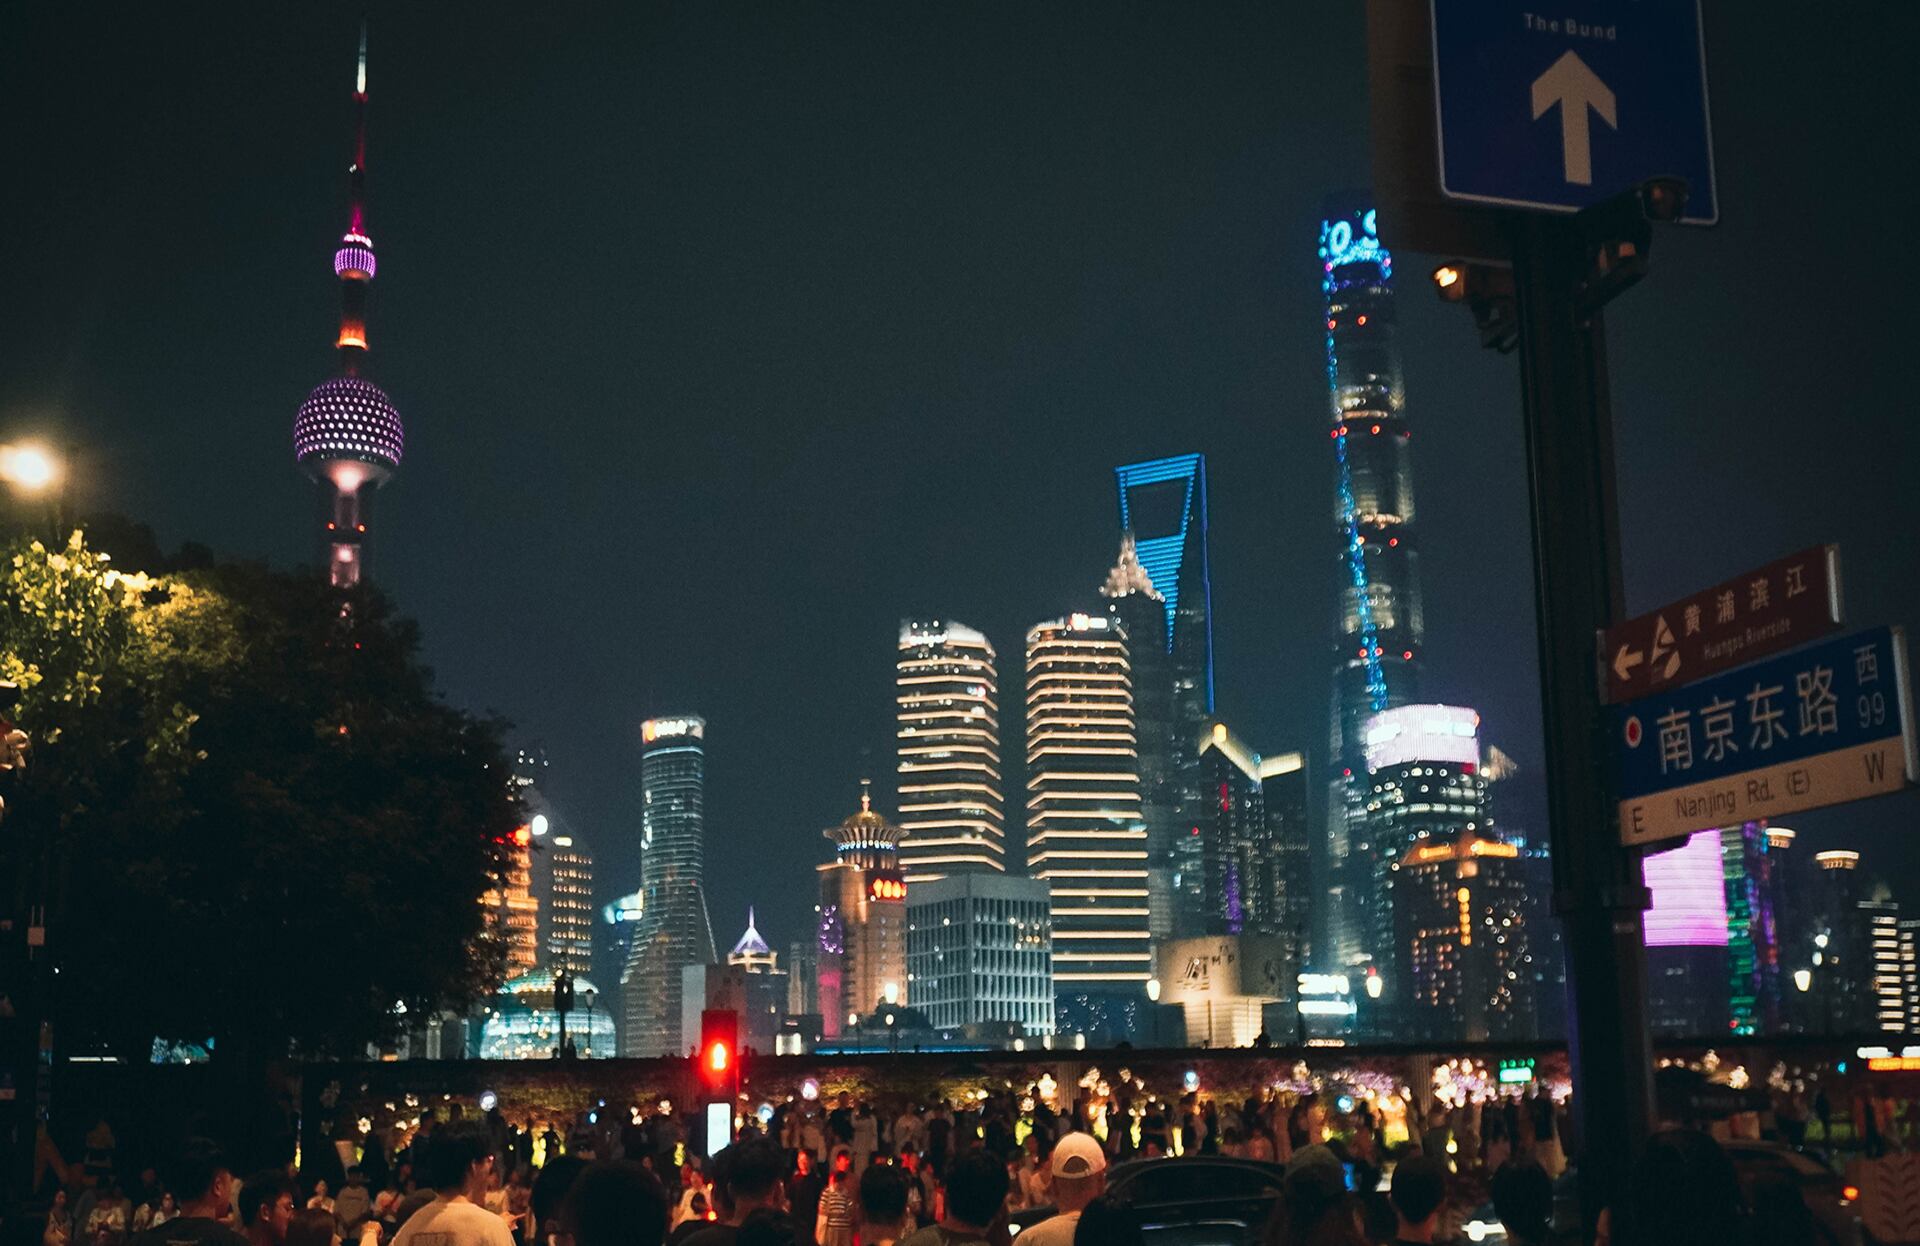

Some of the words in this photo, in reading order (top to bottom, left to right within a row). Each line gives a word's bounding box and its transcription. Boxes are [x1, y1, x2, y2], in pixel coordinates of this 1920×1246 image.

[1523, 13, 1558, 33] The
[1566, 19, 1616, 40] Bund
[1683, 563, 1807, 637] 黄浦滨江
[1852, 643, 1878, 687] 西
[1656, 664, 1839, 774] 南京东路
[1857, 691, 1885, 729] 99
[1864, 751, 1885, 783] W
[1675, 790, 1736, 818] Nanjing
[1747, 776, 1775, 804] Rd.
[1786, 768, 1811, 797] (E)
[1631, 806, 1644, 834] E
